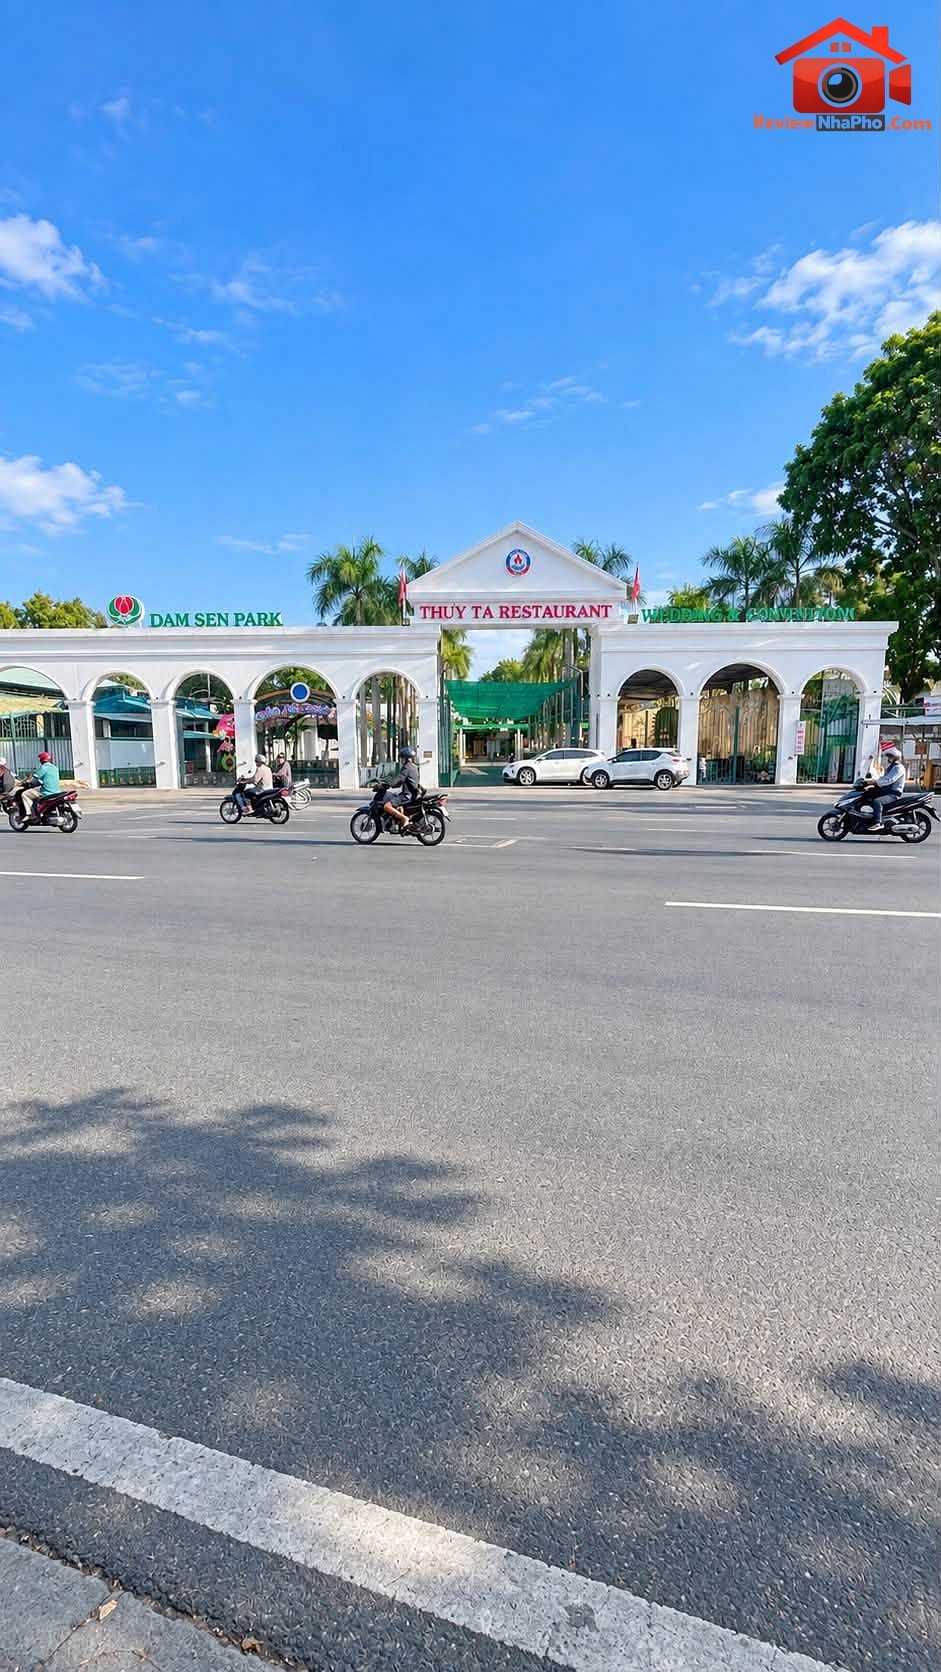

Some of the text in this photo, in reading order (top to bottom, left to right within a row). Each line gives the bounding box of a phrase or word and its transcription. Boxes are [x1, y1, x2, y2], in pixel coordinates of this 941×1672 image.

[150, 611, 283, 627] DAM SEN PARK
[472, 605, 494, 619] TA
[499, 604, 612, 618] RESTAURANT
